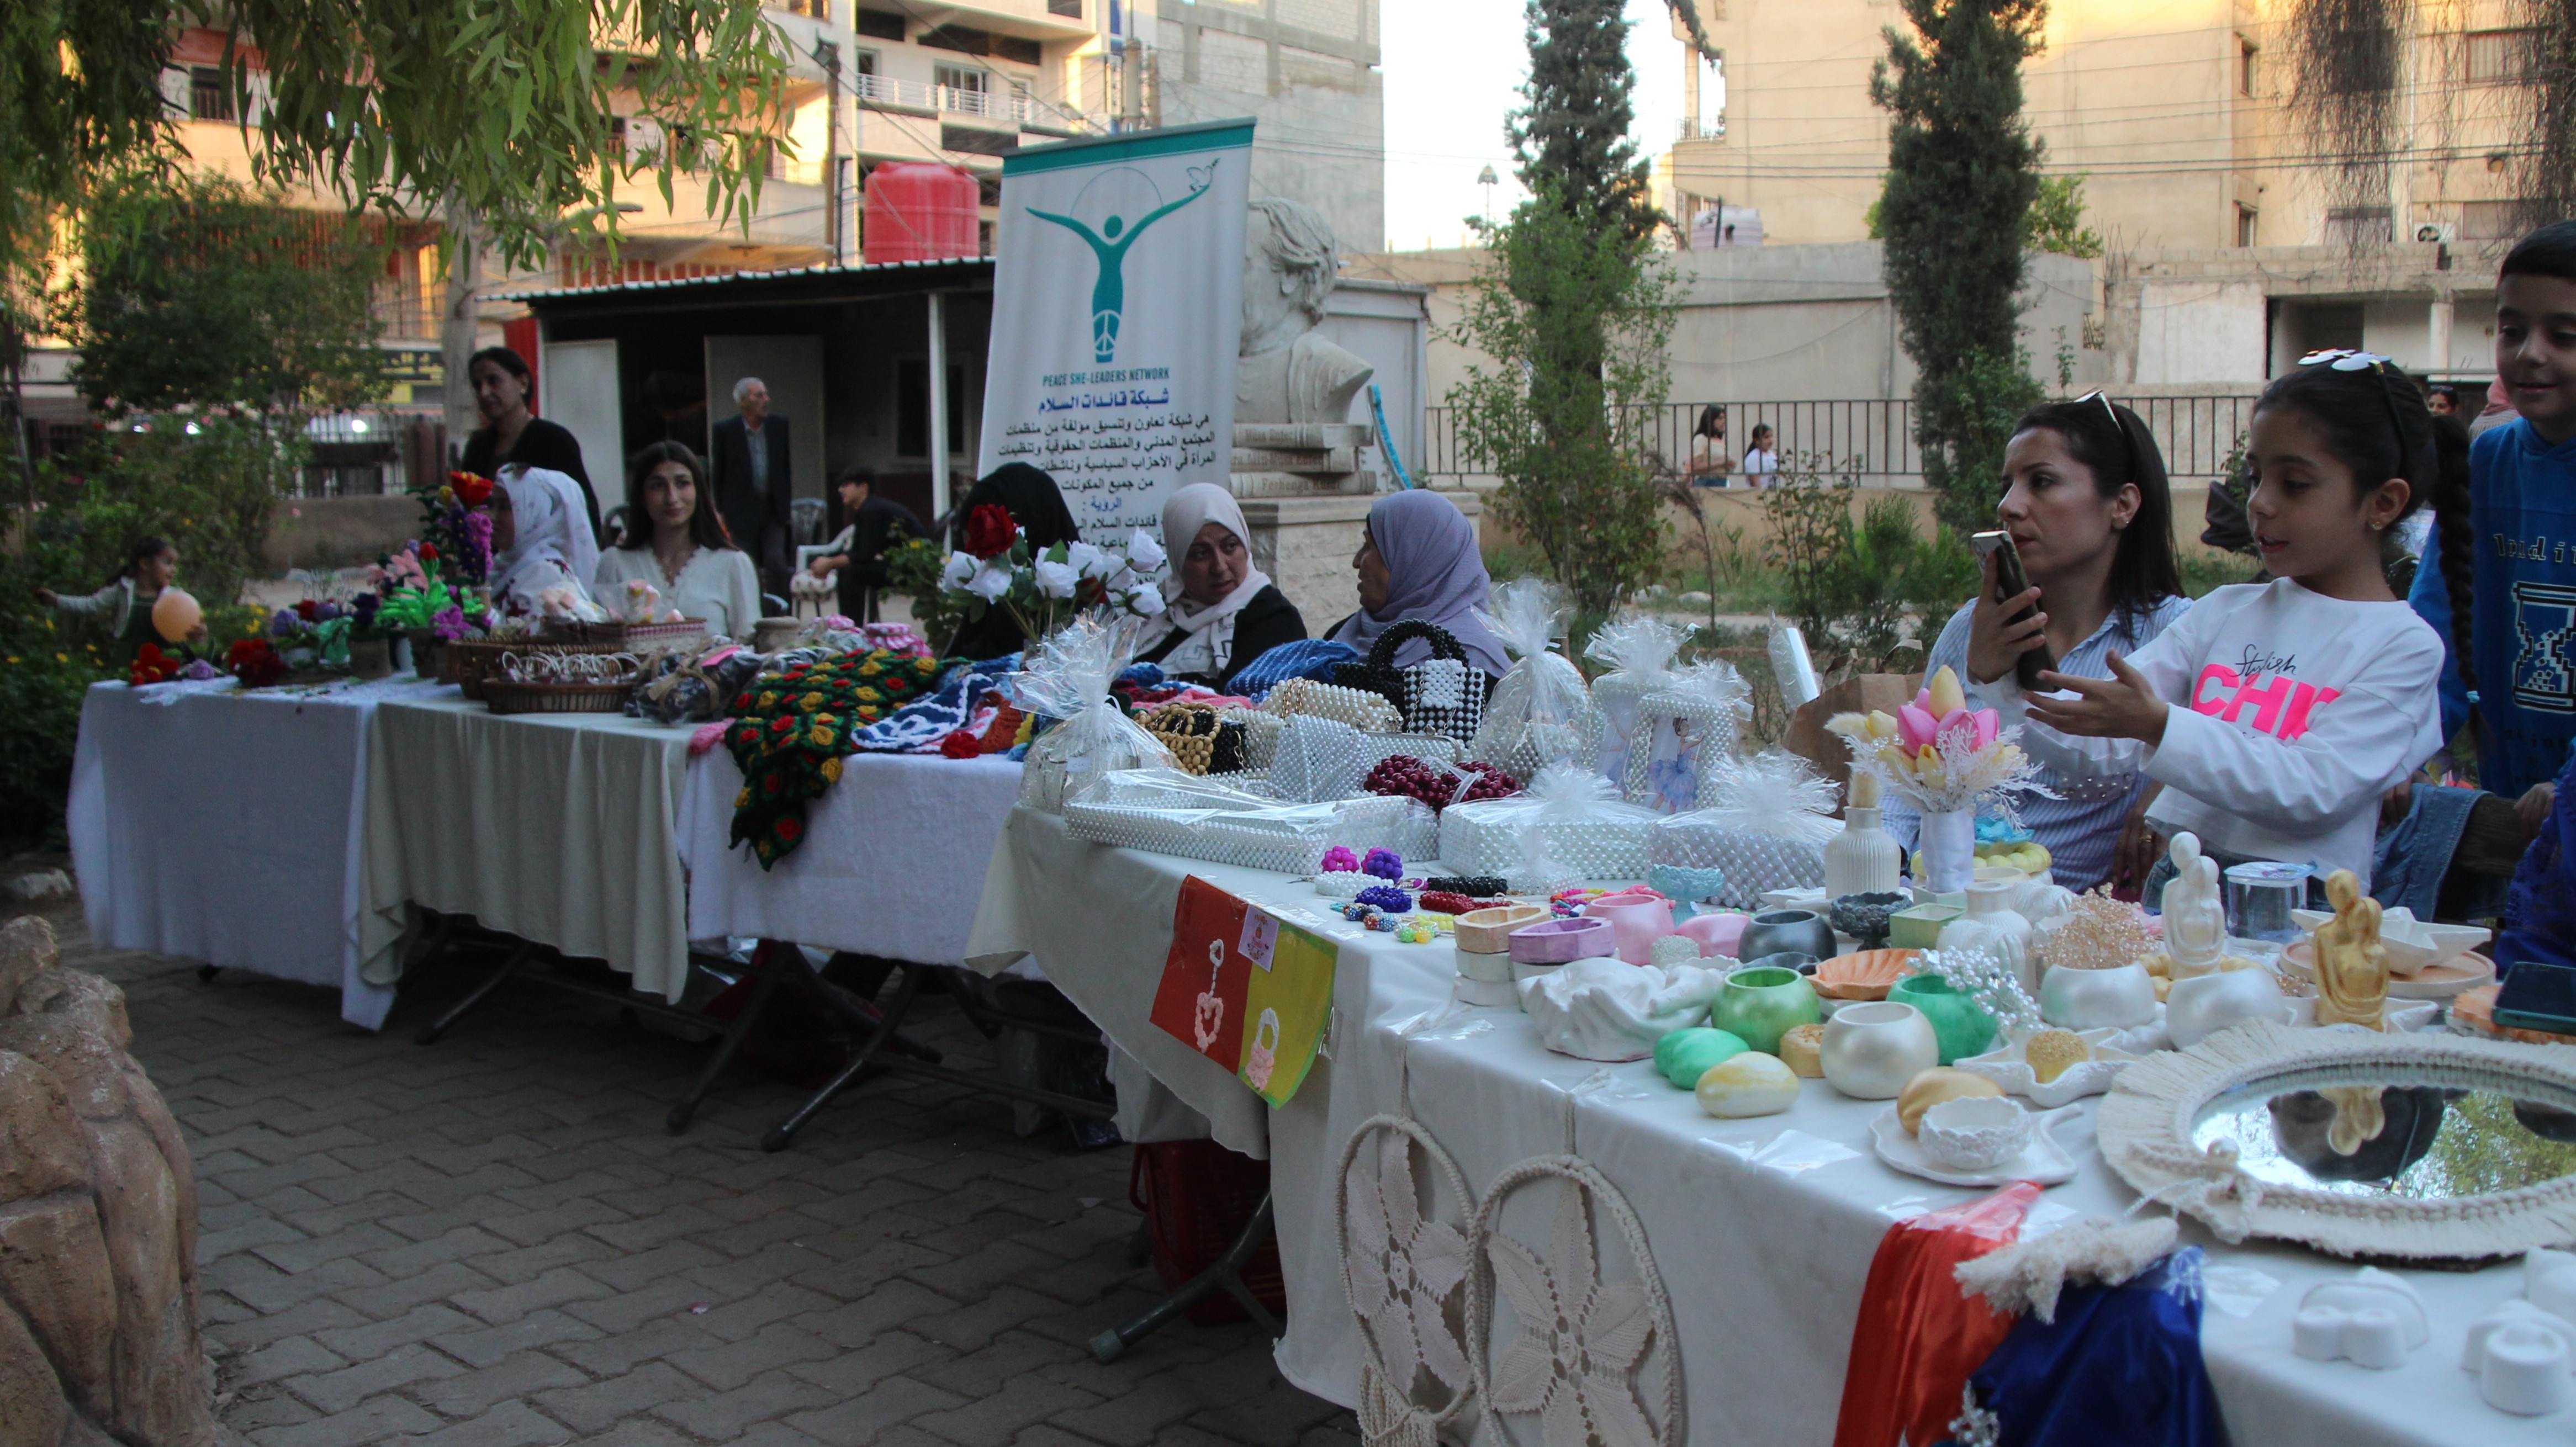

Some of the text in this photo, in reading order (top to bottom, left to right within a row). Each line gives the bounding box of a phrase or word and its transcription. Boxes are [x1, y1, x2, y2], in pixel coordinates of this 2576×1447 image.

[1043, 367, 1169, 387] PEACE SHE-LEADERS NETWORK
[1039, 395, 1079, 414] السلام
[1130, 388, 1168, 409] شبكة
[1006, 413, 1209, 436] هي شبكة تعاون وتنسيق مؤلفة من منظمات
[998, 431, 1215, 457] المجتمع المدني والمنظمات الحقوقية وتنظيمات
[1085, 455, 1127, 472] السياسية
[1132, 453, 1171, 470] الأحزاب
[1175, 452, 1188, 471] في
[1191, 450, 1216, 467] المرأة
[1061, 478, 1153, 494] من جميع المكونات
[1091, 516, 1120, 534] السلام
[2224, 644, 2297, 686] Stylish
